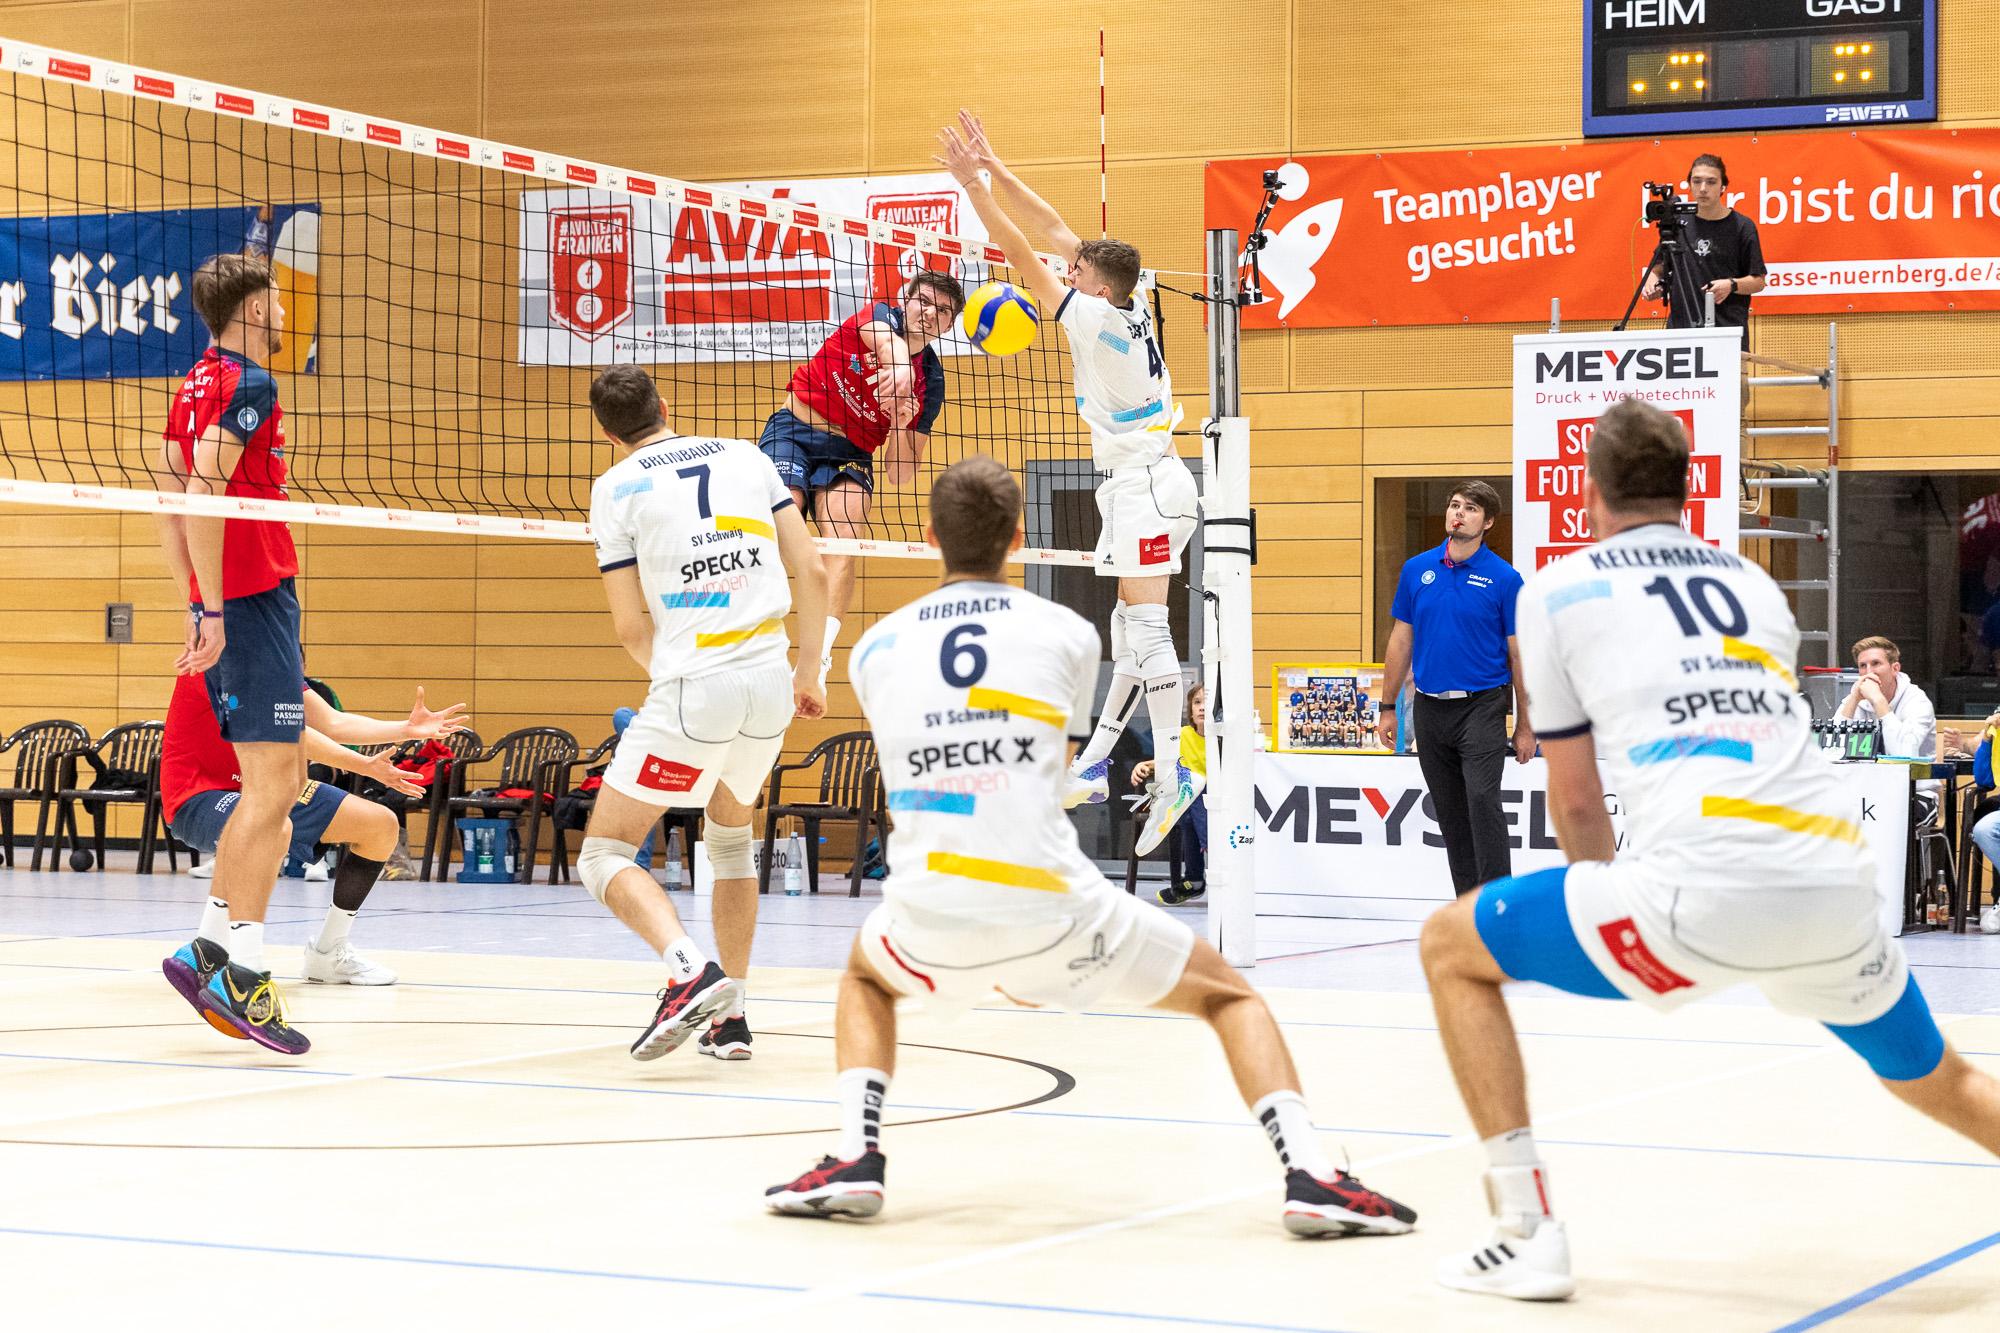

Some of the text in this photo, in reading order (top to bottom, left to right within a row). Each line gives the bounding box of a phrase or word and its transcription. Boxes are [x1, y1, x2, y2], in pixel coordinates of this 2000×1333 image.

[1605, 0, 1705, 29] HEIM
[1825, 104, 1909, 122] PEWETA
[1373, 170, 1602, 225] Teamplayer
[1758, 176, 1855, 225] bist
[1868, 172, 1934, 220] du
[557, 234, 624, 256] FRANKEN
[1407, 217, 1576, 282] gesucht!
[50, 250, 183, 339] Bier
[1145, 337, 1163, 380] 4
[1536, 347, 1719, 383] MEYSEL
[1536, 390, 1582, 404] Druck
[1603, 386, 1716, 402] Werbetechnik
[676, 463, 712, 520] 7
[691, 526, 743, 547] SV Schwaig
[680, 550, 745, 584] SPECK
[919, 598, 1012, 621] BIBRACK
[1643, 575, 1749, 637] 10
[940, 623, 988, 688] 6
[925, 704, 1010, 728] SV Schwaig
[1665, 688, 1773, 725] SPECK
[908, 738, 1004, 777] SPECK
